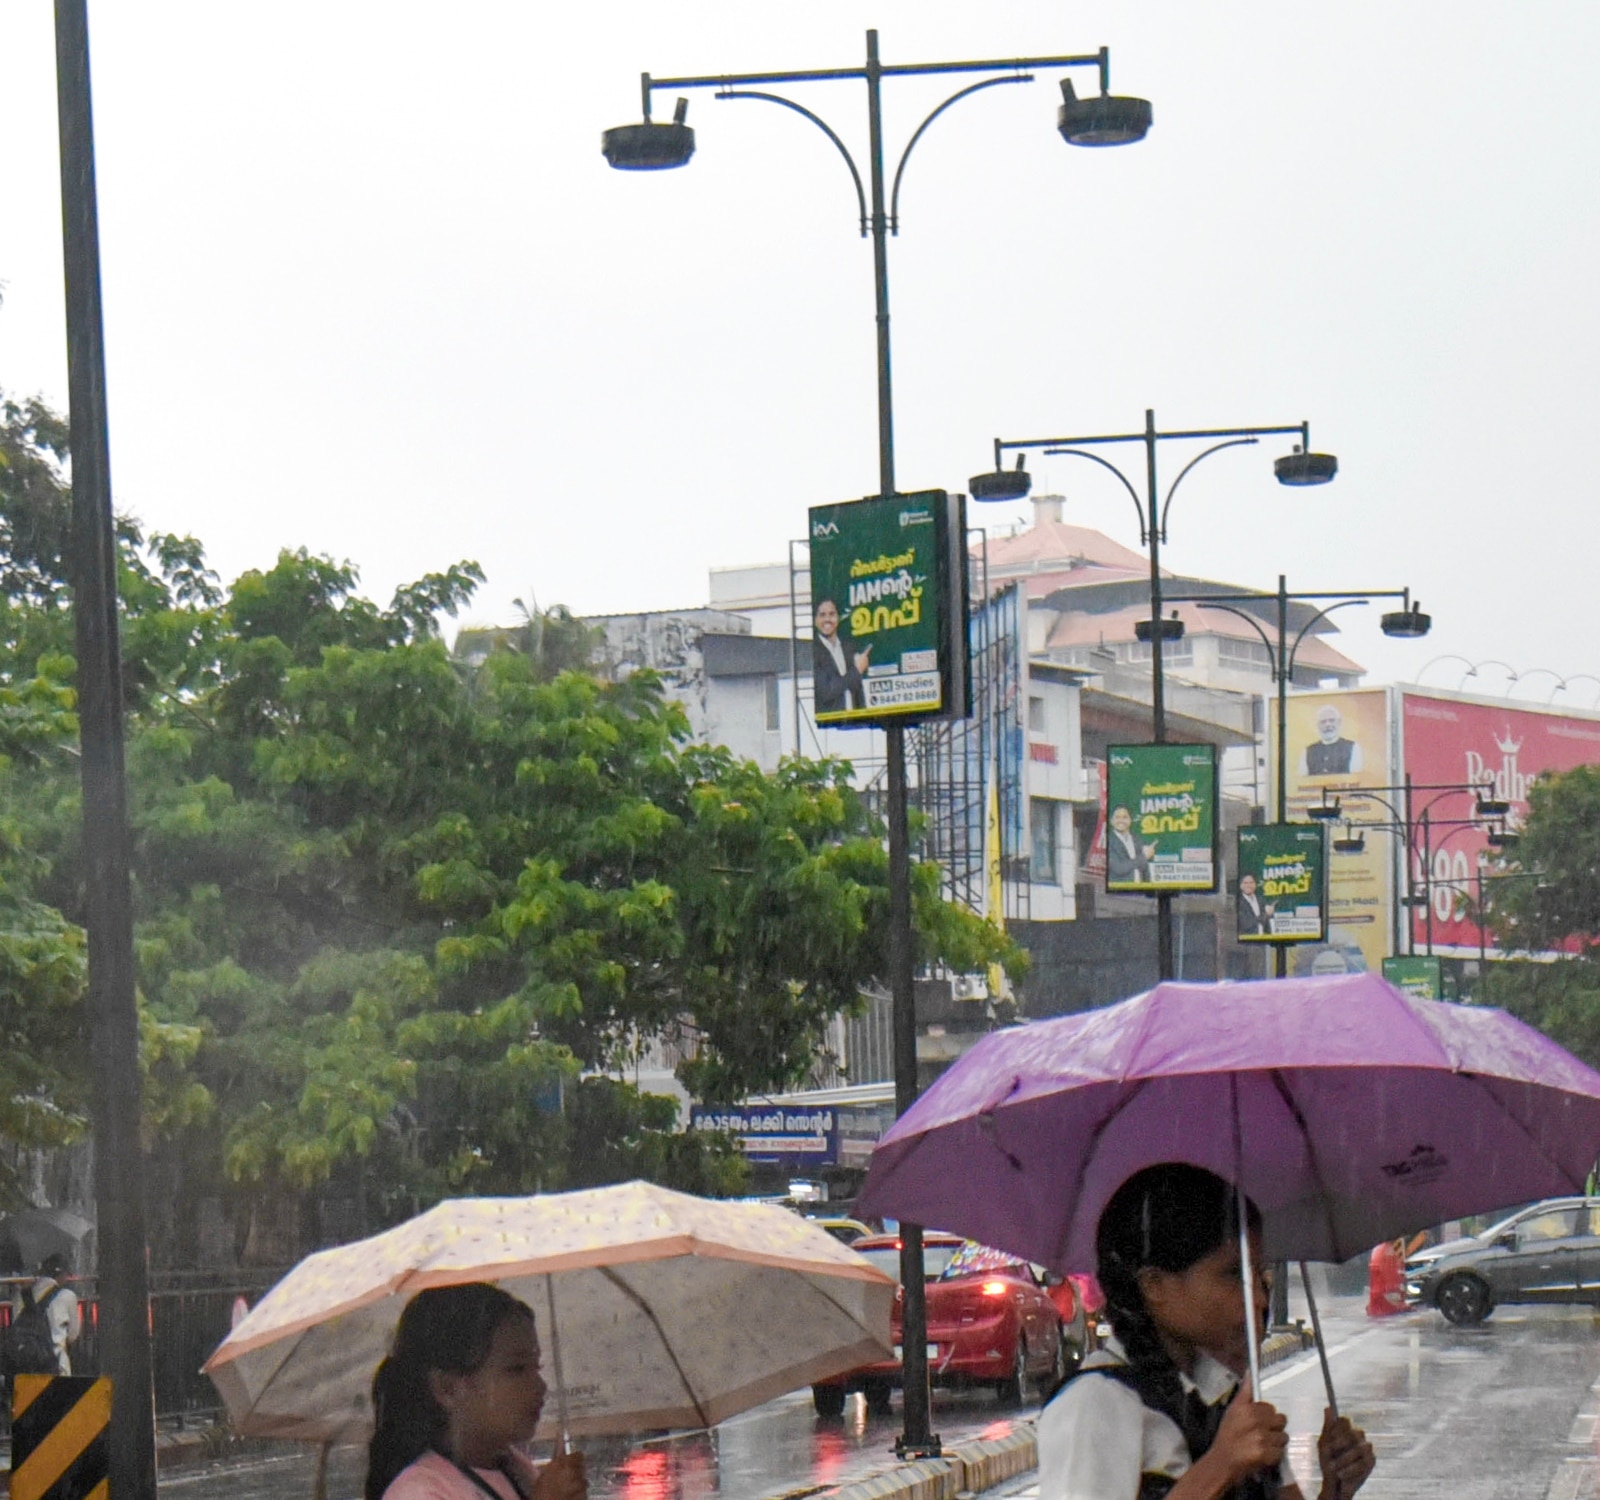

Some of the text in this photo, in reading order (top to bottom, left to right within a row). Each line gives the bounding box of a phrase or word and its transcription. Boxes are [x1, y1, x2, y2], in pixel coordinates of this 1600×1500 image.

[850, 586, 924, 637] ഉറപ്പ്
[894, 678, 935, 691] Studies
[750, 1110, 785, 1132] ലക്കി
